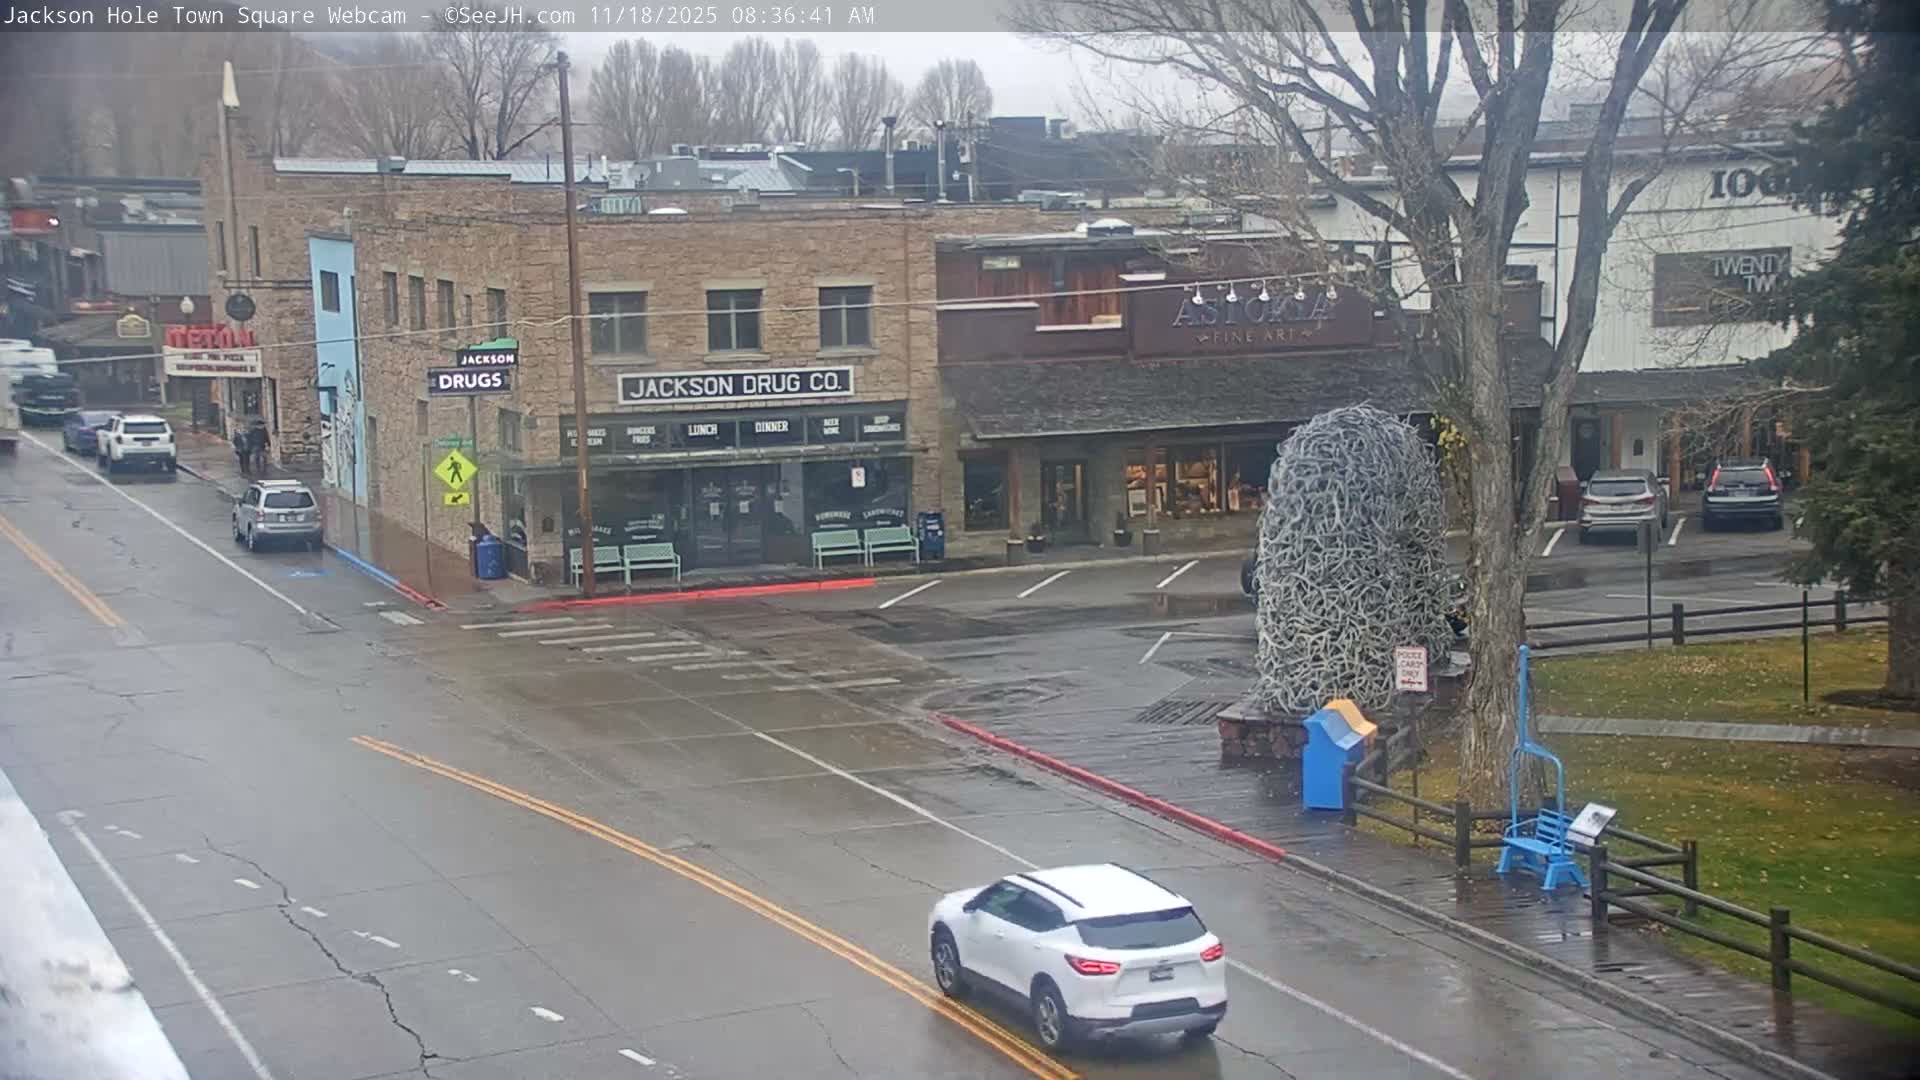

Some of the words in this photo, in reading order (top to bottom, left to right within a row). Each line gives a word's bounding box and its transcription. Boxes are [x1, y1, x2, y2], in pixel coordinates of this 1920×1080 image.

[1711, 254, 1789, 277] TWENTY
[1743, 275, 1788, 293] TW
[1172, 292, 1336, 327] ASTORIA
[165, 326, 257, 350] TETON
[1213, 331, 1253, 345] FINE
[1263, 329, 1295, 342] ART
[461, 354, 515, 365] JACKSON
[439, 372, 502, 390] DRUGS
[629, 376, 734, 398] JACKSON
[743, 374, 801, 394] DRUG
[809, 372, 843, 391] CO.
[688, 423, 718, 436] LUNCH
[755, 420, 789, 433] DINNER
[1397, 651, 1422, 659] POLICE
[1401, 669, 1419, 678] ONLY
